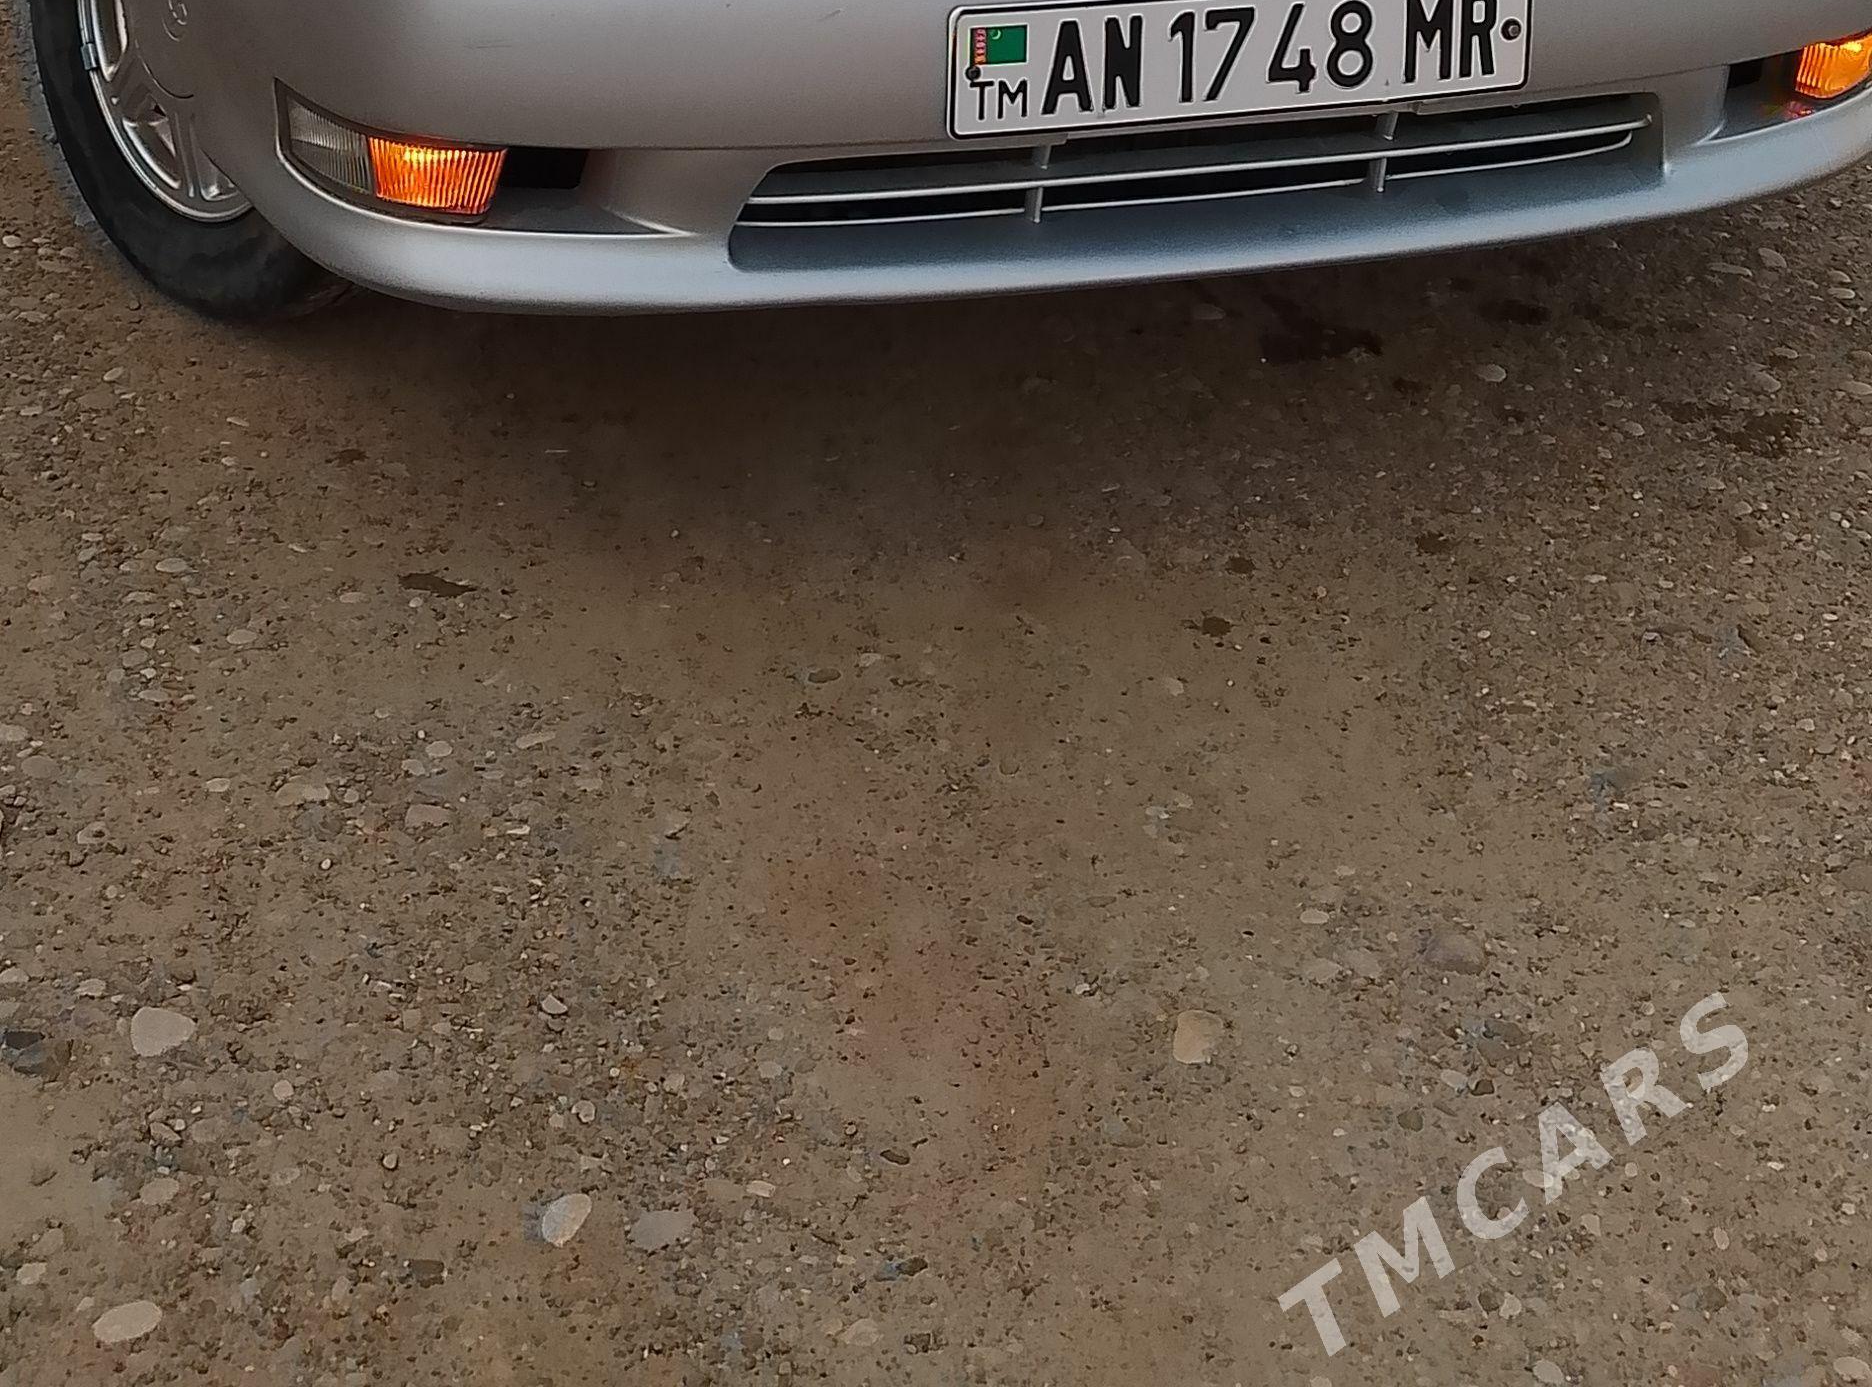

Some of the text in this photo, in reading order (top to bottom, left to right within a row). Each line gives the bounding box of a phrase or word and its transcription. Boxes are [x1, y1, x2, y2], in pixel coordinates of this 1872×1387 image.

[1041, 15, 1143, 115] AN
[1170, 0, 1373, 104] 1748
[970, 79, 1028, 120] TM
